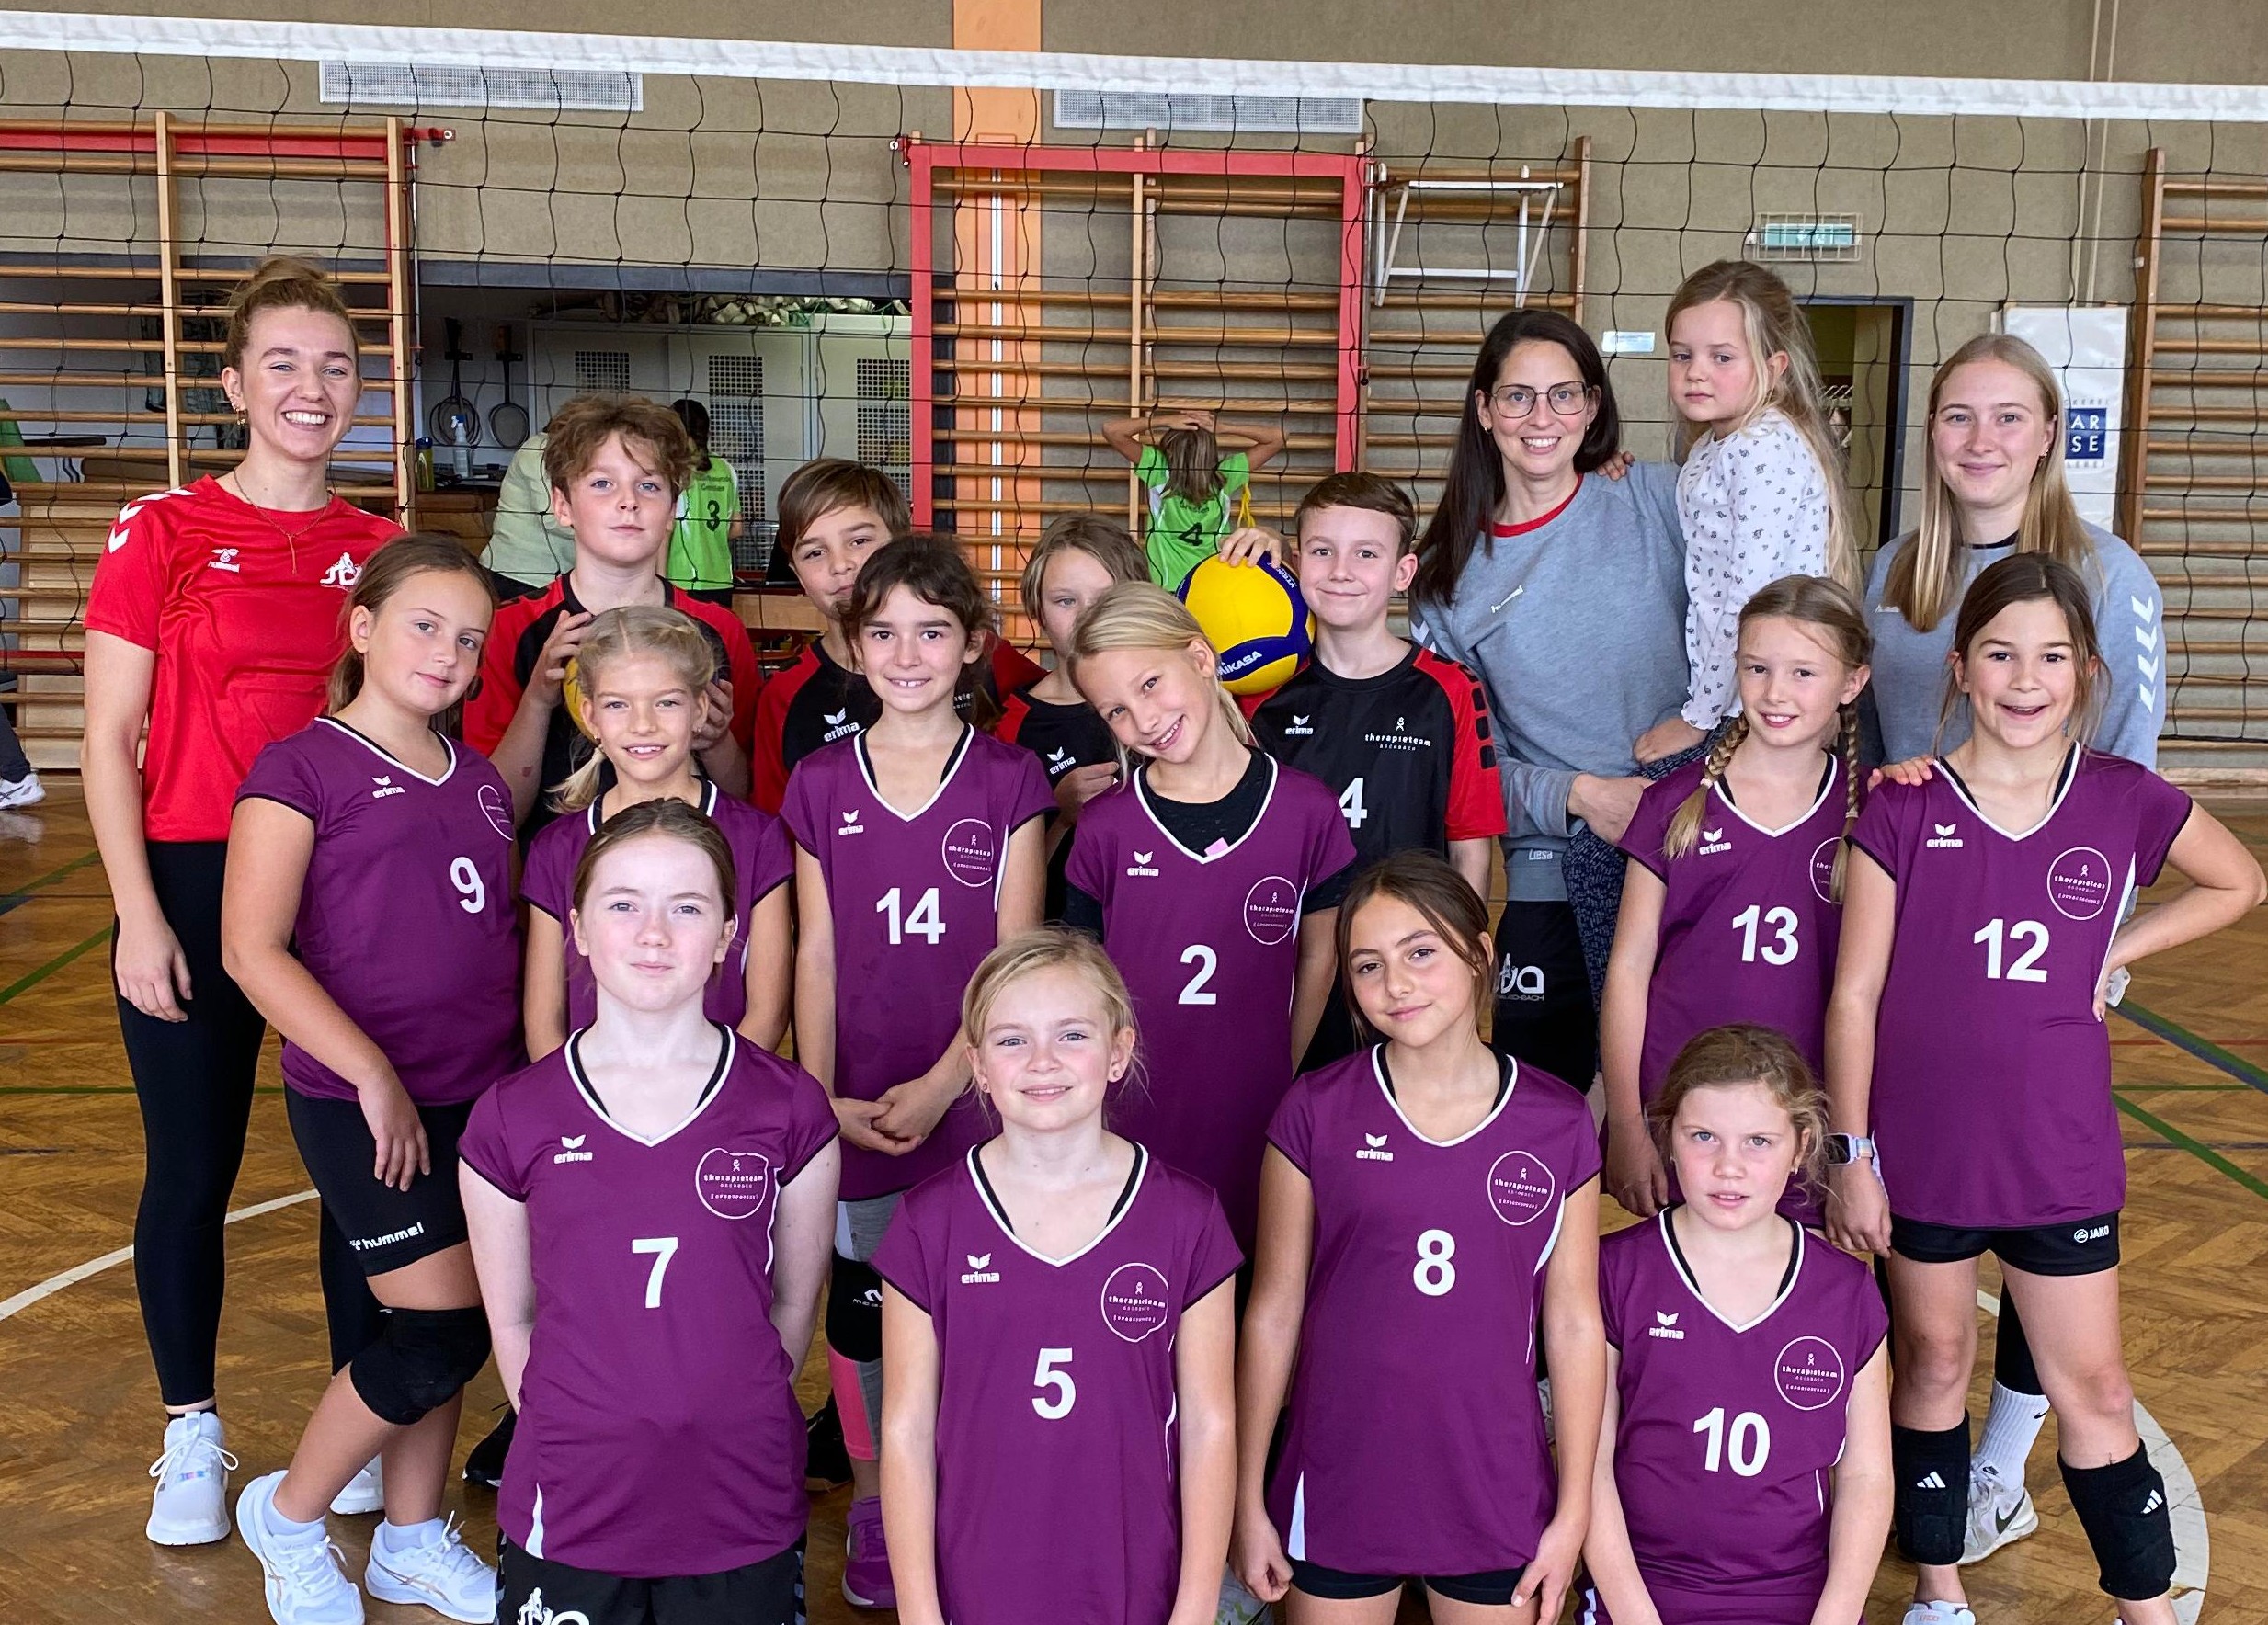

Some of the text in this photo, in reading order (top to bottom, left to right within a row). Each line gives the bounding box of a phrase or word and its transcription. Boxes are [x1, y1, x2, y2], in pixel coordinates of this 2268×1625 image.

[707, 499, 720, 532] 3
[1178, 522, 1203, 546] 4
[823, 722, 860, 743] erima
[1284, 725, 1314, 735] erima
[1364, 733, 1432, 747] therapieteam
[1049, 756, 1076, 776] erima
[372, 787, 405, 799] erima
[1339, 777, 1368, 829] 4
[838, 824, 864, 835] erima
[1699, 842, 1732, 856] erima
[1926, 837, 1964, 848] erima
[1127, 867, 1159, 877] erima
[450, 856, 486, 915] 9
[876, 887, 945, 945] 14
[1732, 904, 1799, 966] 13
[1973, 917, 2051, 983] 12
[1177, 945, 1216, 1006] 2
[553, 1151, 593, 1165] erima
[1356, 1149, 1393, 1162] erima
[359, 1222, 424, 1250] hummel
[2089, 1225, 2110, 1240] JAKO
[632, 1236, 678, 1309] 7
[1413, 1228, 1455, 1297] 8
[961, 1271, 1000, 1284] erima
[1648, 1326, 1684, 1340] erima
[1031, 1347, 1076, 1420] 5
[1692, 1406, 1771, 1477] 10
